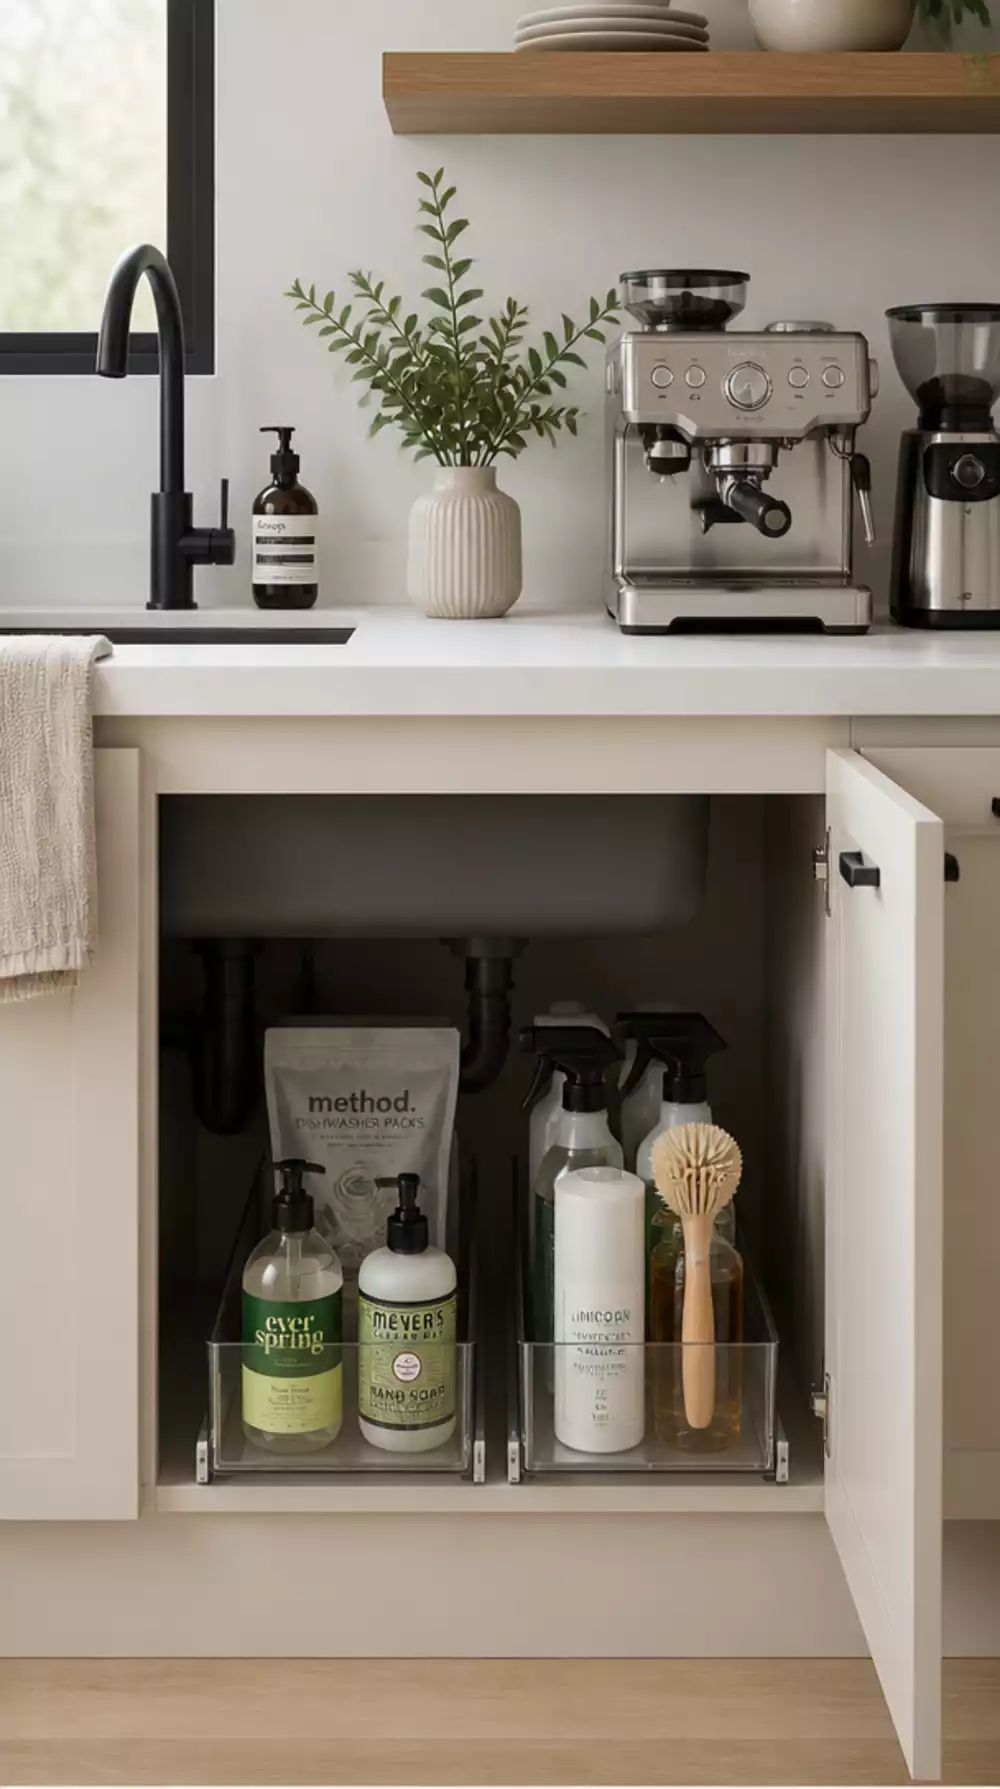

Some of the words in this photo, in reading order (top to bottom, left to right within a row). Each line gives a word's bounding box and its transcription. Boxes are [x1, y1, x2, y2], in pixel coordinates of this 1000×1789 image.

[308, 1089, 416, 1113] method.
[265, 1315, 315, 1332] ever
[255, 1329, 325, 1355] spring
